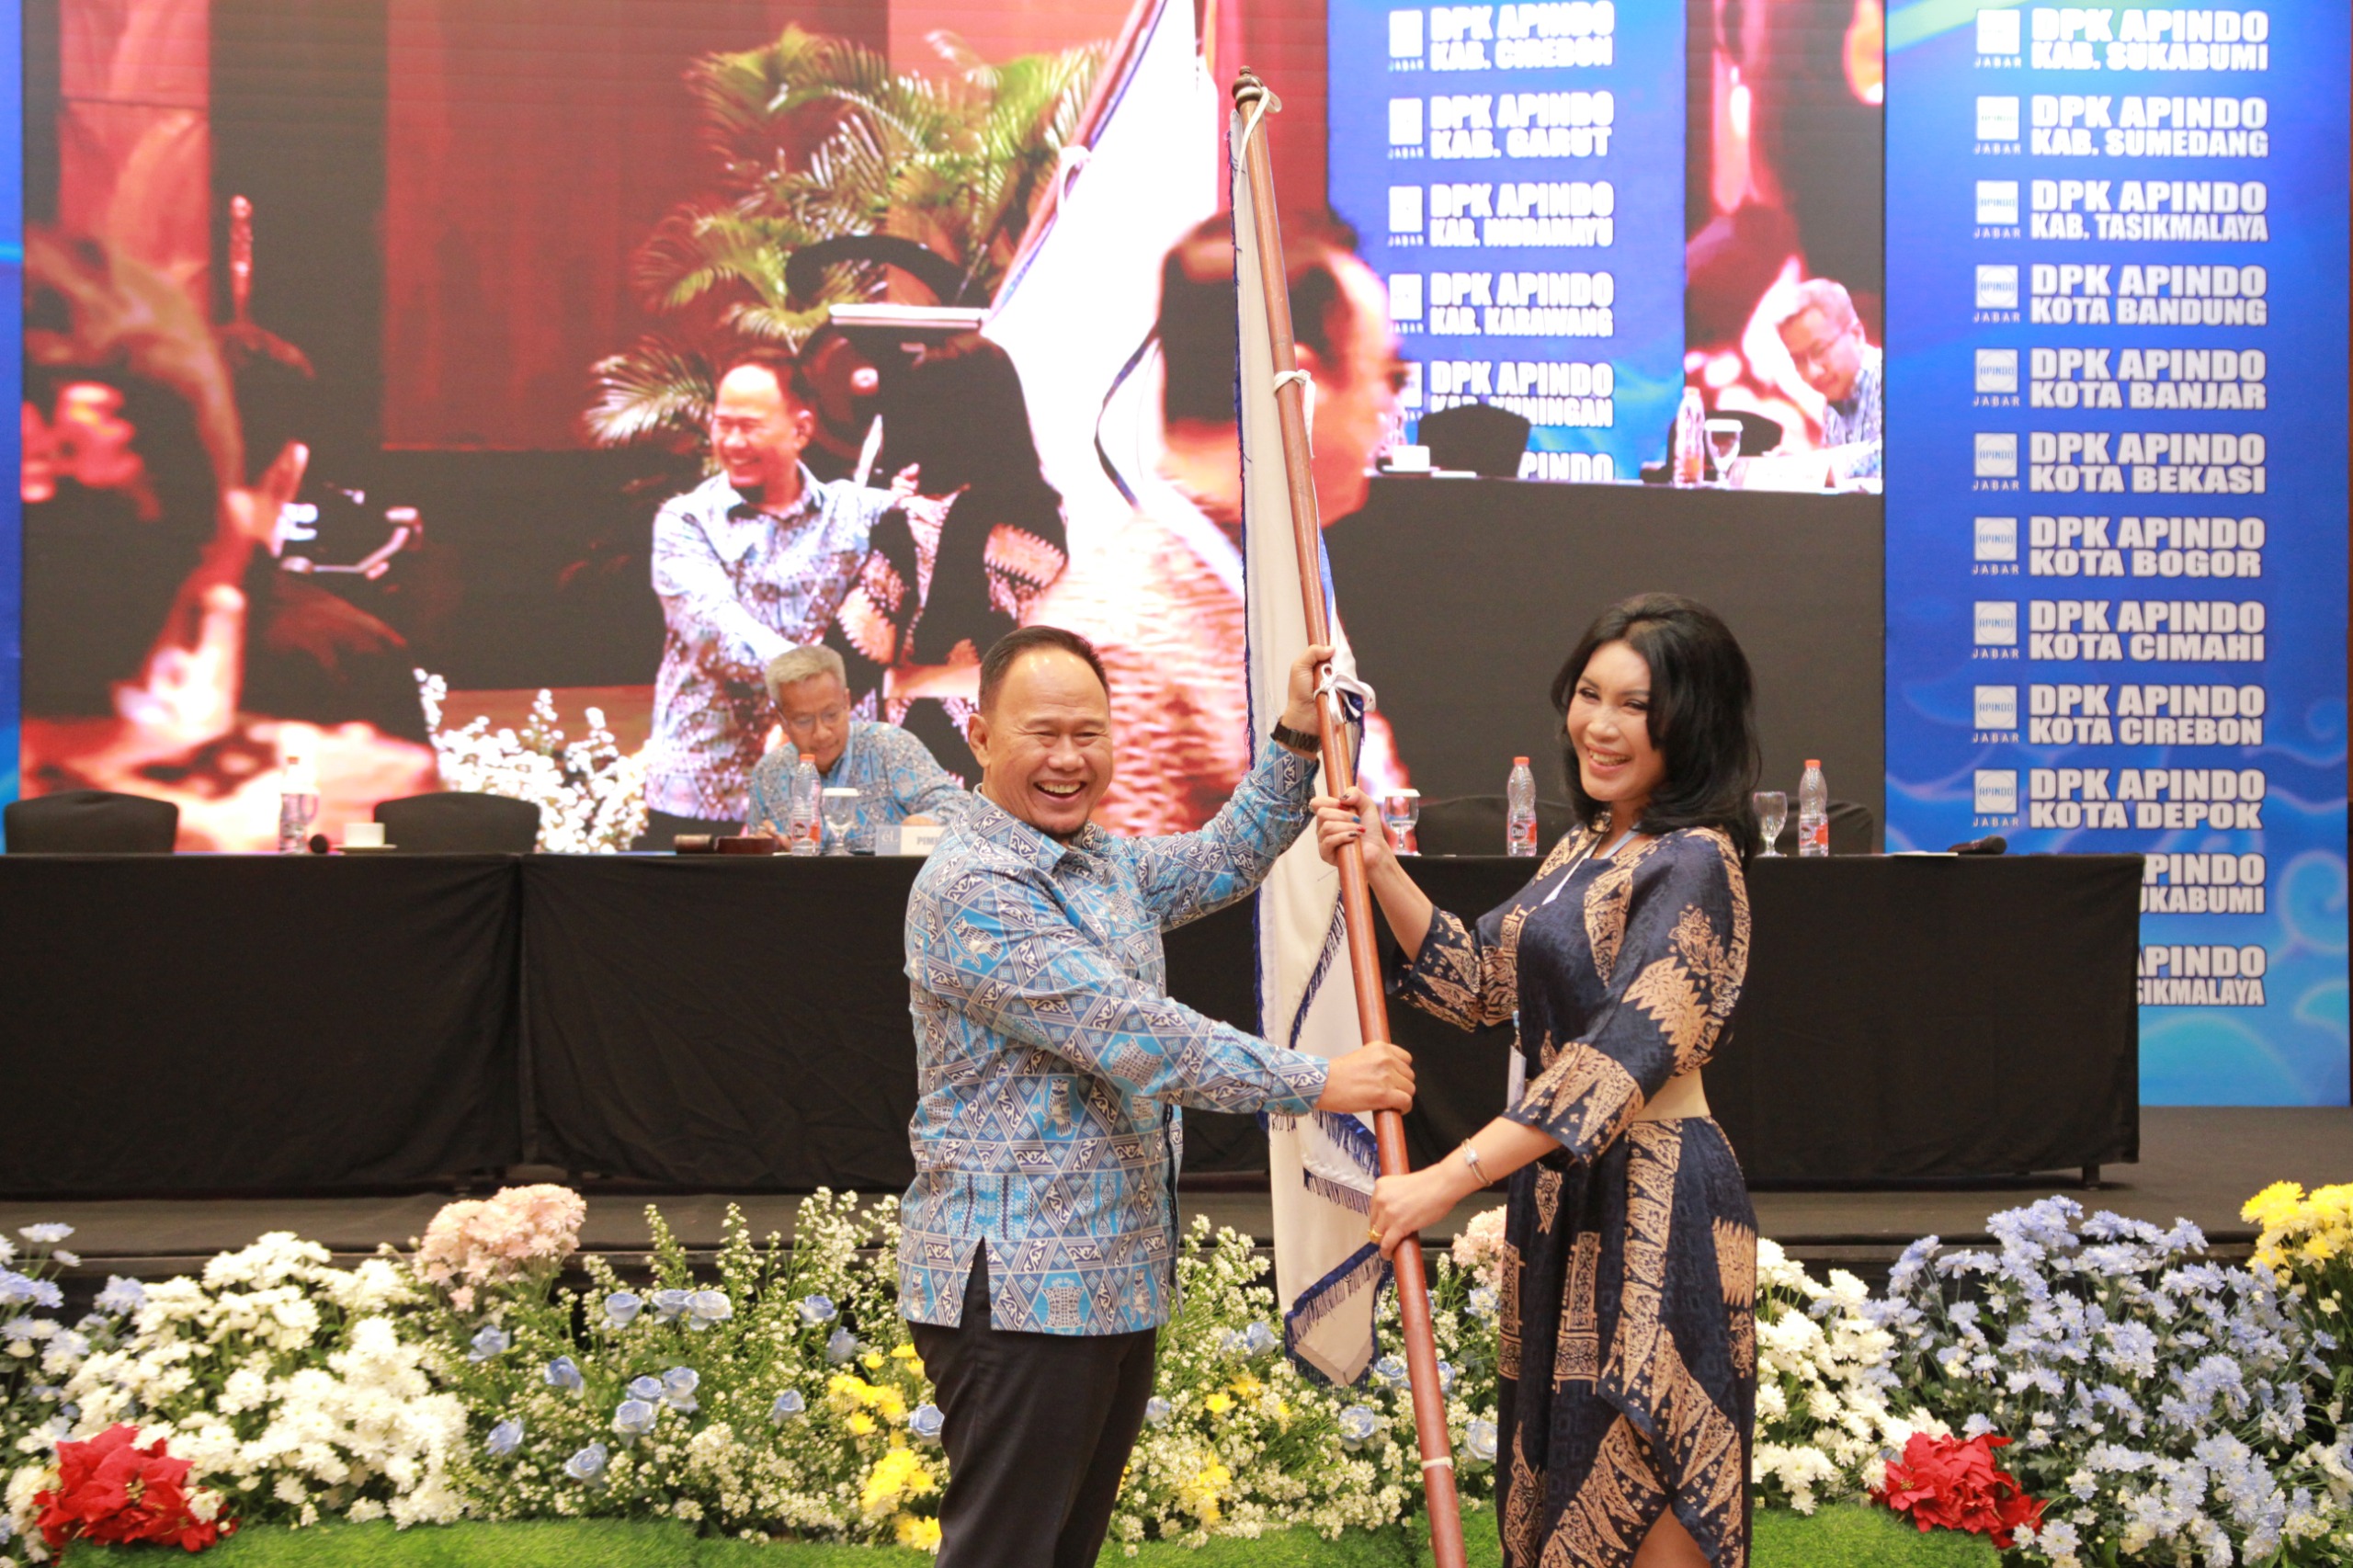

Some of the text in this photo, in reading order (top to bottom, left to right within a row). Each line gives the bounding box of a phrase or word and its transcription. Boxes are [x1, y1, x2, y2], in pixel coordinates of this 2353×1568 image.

[1430, 0, 1614, 41] DPK APINDO
[2032, 7, 2268, 42] DPK APINDO
[1430, 40, 1493, 71] KAB.
[2031, 42, 2268, 70] KAB. SUKABUMI
[1430, 91, 1614, 129] DPK APINDO
[2031, 95, 2267, 129] DPK APINDO
[1430, 129, 1502, 159] KAB.
[2031, 129, 2268, 156] KAB. SUMEDANG
[1430, 181, 1614, 217] DPK APINDO
[2031, 179, 2266, 212] DPK APINDO
[1430, 217, 1481, 246] KAB.
[1973, 227, 2020, 240] JABAR
[2030, 212, 2268, 240] KAB. TASIKMALAYA
[1430, 272, 1614, 306] DPK APINDO
[2031, 264, 2266, 297] DPK APINDO
[1430, 306, 1613, 336] KAB. KARAWANG
[1973, 312, 2020, 324] JABAR
[2030, 296, 2266, 324] KOTA BANDUNG
[1430, 360, 1614, 396] DPK APINDO
[1979, 366, 2014, 376] APINDO
[2030, 348, 2265, 381] DPK APINDO
[1972, 396, 2020, 408] JABAR
[2030, 381, 2266, 408] KOTA BANJAR
[1979, 450, 2014, 460] APINDO
[2030, 432, 2265, 465] DPK APINDO
[1518, 451, 1614, 482] PINDO
[2030, 465, 2265, 493] KOTA BEKASI
[1972, 481, 2019, 493] JABAR
[1979, 533, 2014, 544] APINDO
[2030, 517, 2265, 549] DPK APINDO
[1972, 563, 2019, 575] JABAR
[2030, 549, 2260, 576] KOTA BOGOR
[1979, 619, 2014, 629] APINDO
[2030, 601, 2264, 632] DPK APINDO
[1972, 648, 2019, 660] JABAR
[2030, 633, 2264, 660] KOTA CIMAHI
[1979, 702, 2014, 713] APINDO
[2030, 685, 2264, 717] DPK APINDO
[1972, 733, 2019, 744] JABAR
[2030, 718, 2261, 744] KOTA CIREBON
[1979, 787, 2014, 797] APINDO
[2030, 769, 2264, 801] DPK APINDO
[1972, 816, 2019, 827] JABAR
[2030, 801, 2261, 828] KOTA DEPOK
[2143, 854, 2264, 884] PINDO
